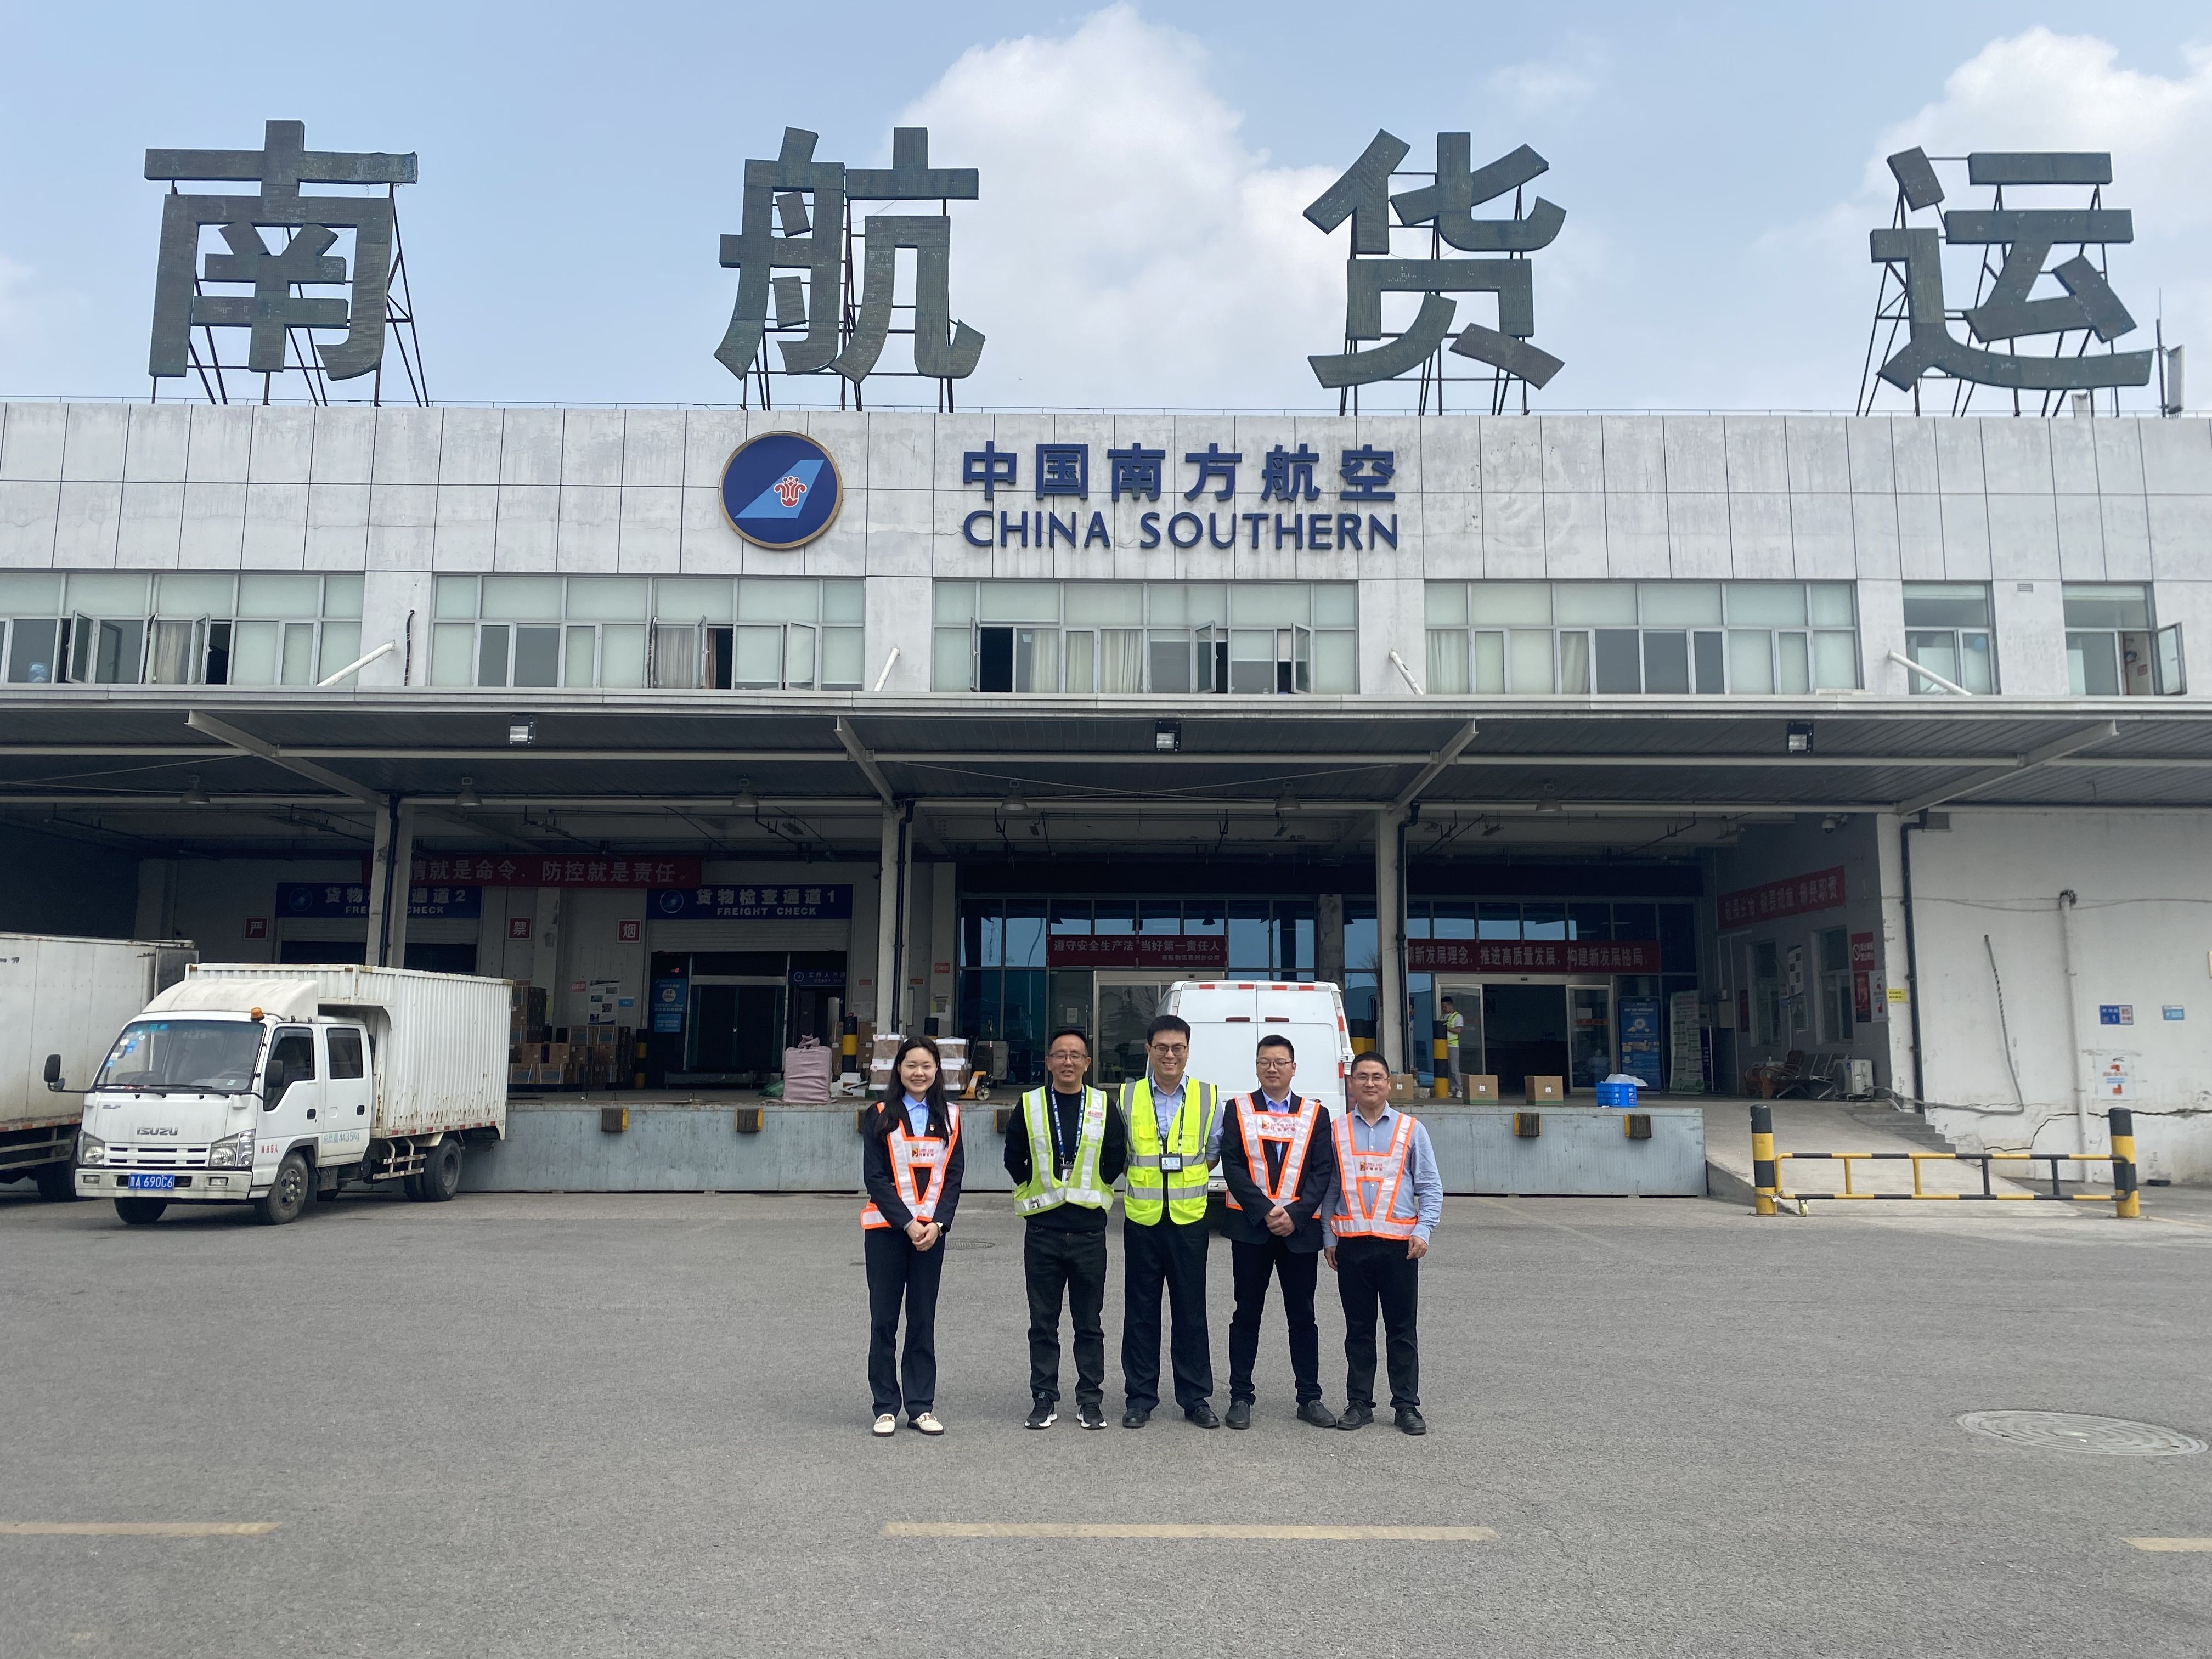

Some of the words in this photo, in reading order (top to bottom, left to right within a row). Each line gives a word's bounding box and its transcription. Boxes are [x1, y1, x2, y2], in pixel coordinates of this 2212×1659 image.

[144, 120, 2154, 392] 南航货运
[963, 441, 1396, 501] 中国南方航空
[963, 511, 1110, 549] CHINA
[1141, 511, 1398, 550] SOUTHERN
[325, 887, 466, 904] 货物通道2
[717, 907, 768, 916] FREIGHT
[776, 907, 816, 915] CHECK
[250, 921, 263, 935] 严
[513, 921, 527, 936] 禁
[623, 923, 636, 939] 烟
[1054, 939, 1134, 952] 遵守安全生产法
[1141, 940, 1220, 952] 当好第一责任人
[137, 1127, 179, 1136] ISUZU
